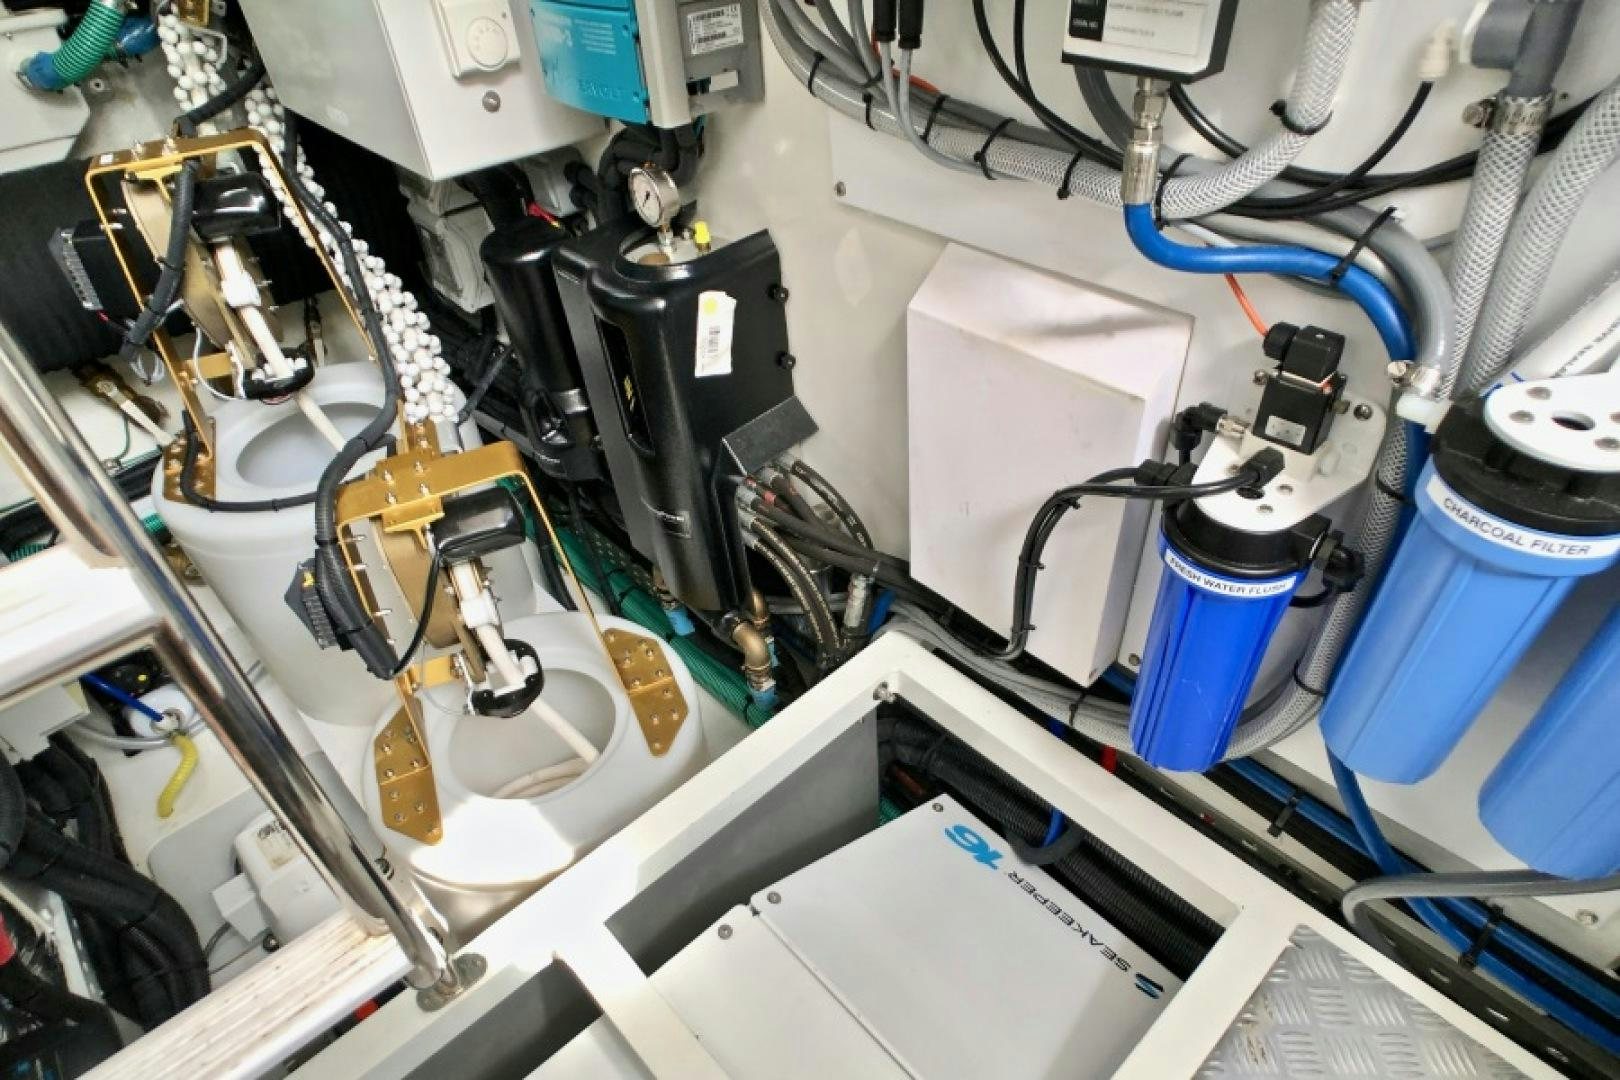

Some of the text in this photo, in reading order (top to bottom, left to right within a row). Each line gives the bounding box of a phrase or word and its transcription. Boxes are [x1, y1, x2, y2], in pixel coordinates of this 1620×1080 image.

[1443, 497, 1592, 555] CHARCOAL FILTER
[1203, 578, 1246, 593] WATER
[945, 824, 1132, 973] SEAKEEPER 16
